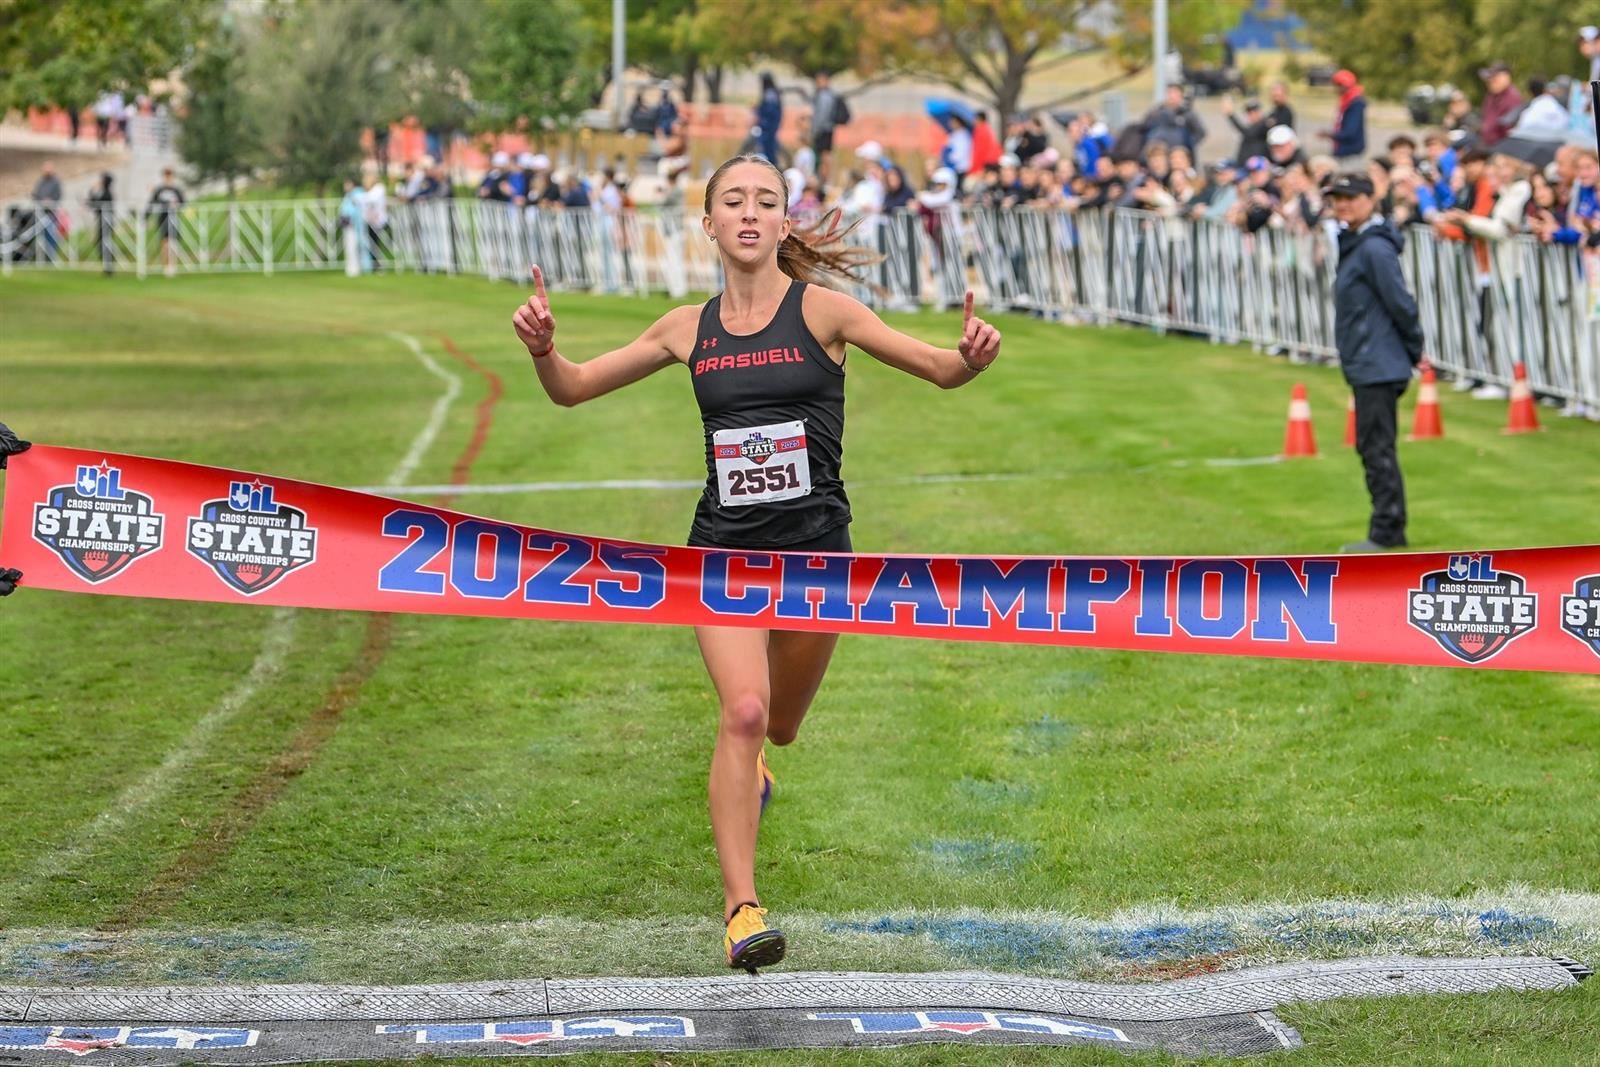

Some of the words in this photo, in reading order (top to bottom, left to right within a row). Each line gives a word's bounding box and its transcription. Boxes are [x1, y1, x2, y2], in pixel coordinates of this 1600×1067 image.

[695, 347, 804, 376] BRASWELL
[741, 443, 776, 455] STATE
[781, 440, 799, 449] 2025
[728, 462, 800, 496] 2551
[67, 499, 93, 510] CROSS
[95, 502, 133, 513] COUNTRY
[38, 507, 160, 544] STATE
[220, 513, 246, 524] CROSS
[247, 515, 287, 528] COUNTRY
[58, 537, 135, 553] CHAMPIONSHIPS
[191, 521, 313, 558] STATE
[212, 551, 289, 567] CHAMPIONSHIPS
[377, 508, 668, 609] 2025
[700, 550, 1340, 644] CHAMPION
[1440, 583, 1466, 594] CROSS
[1467, 585, 1507, 595] COUNTRY
[1412, 594, 1533, 624] STATE
[1434, 622, 1510, 635] CHAMPIONSHIPS
